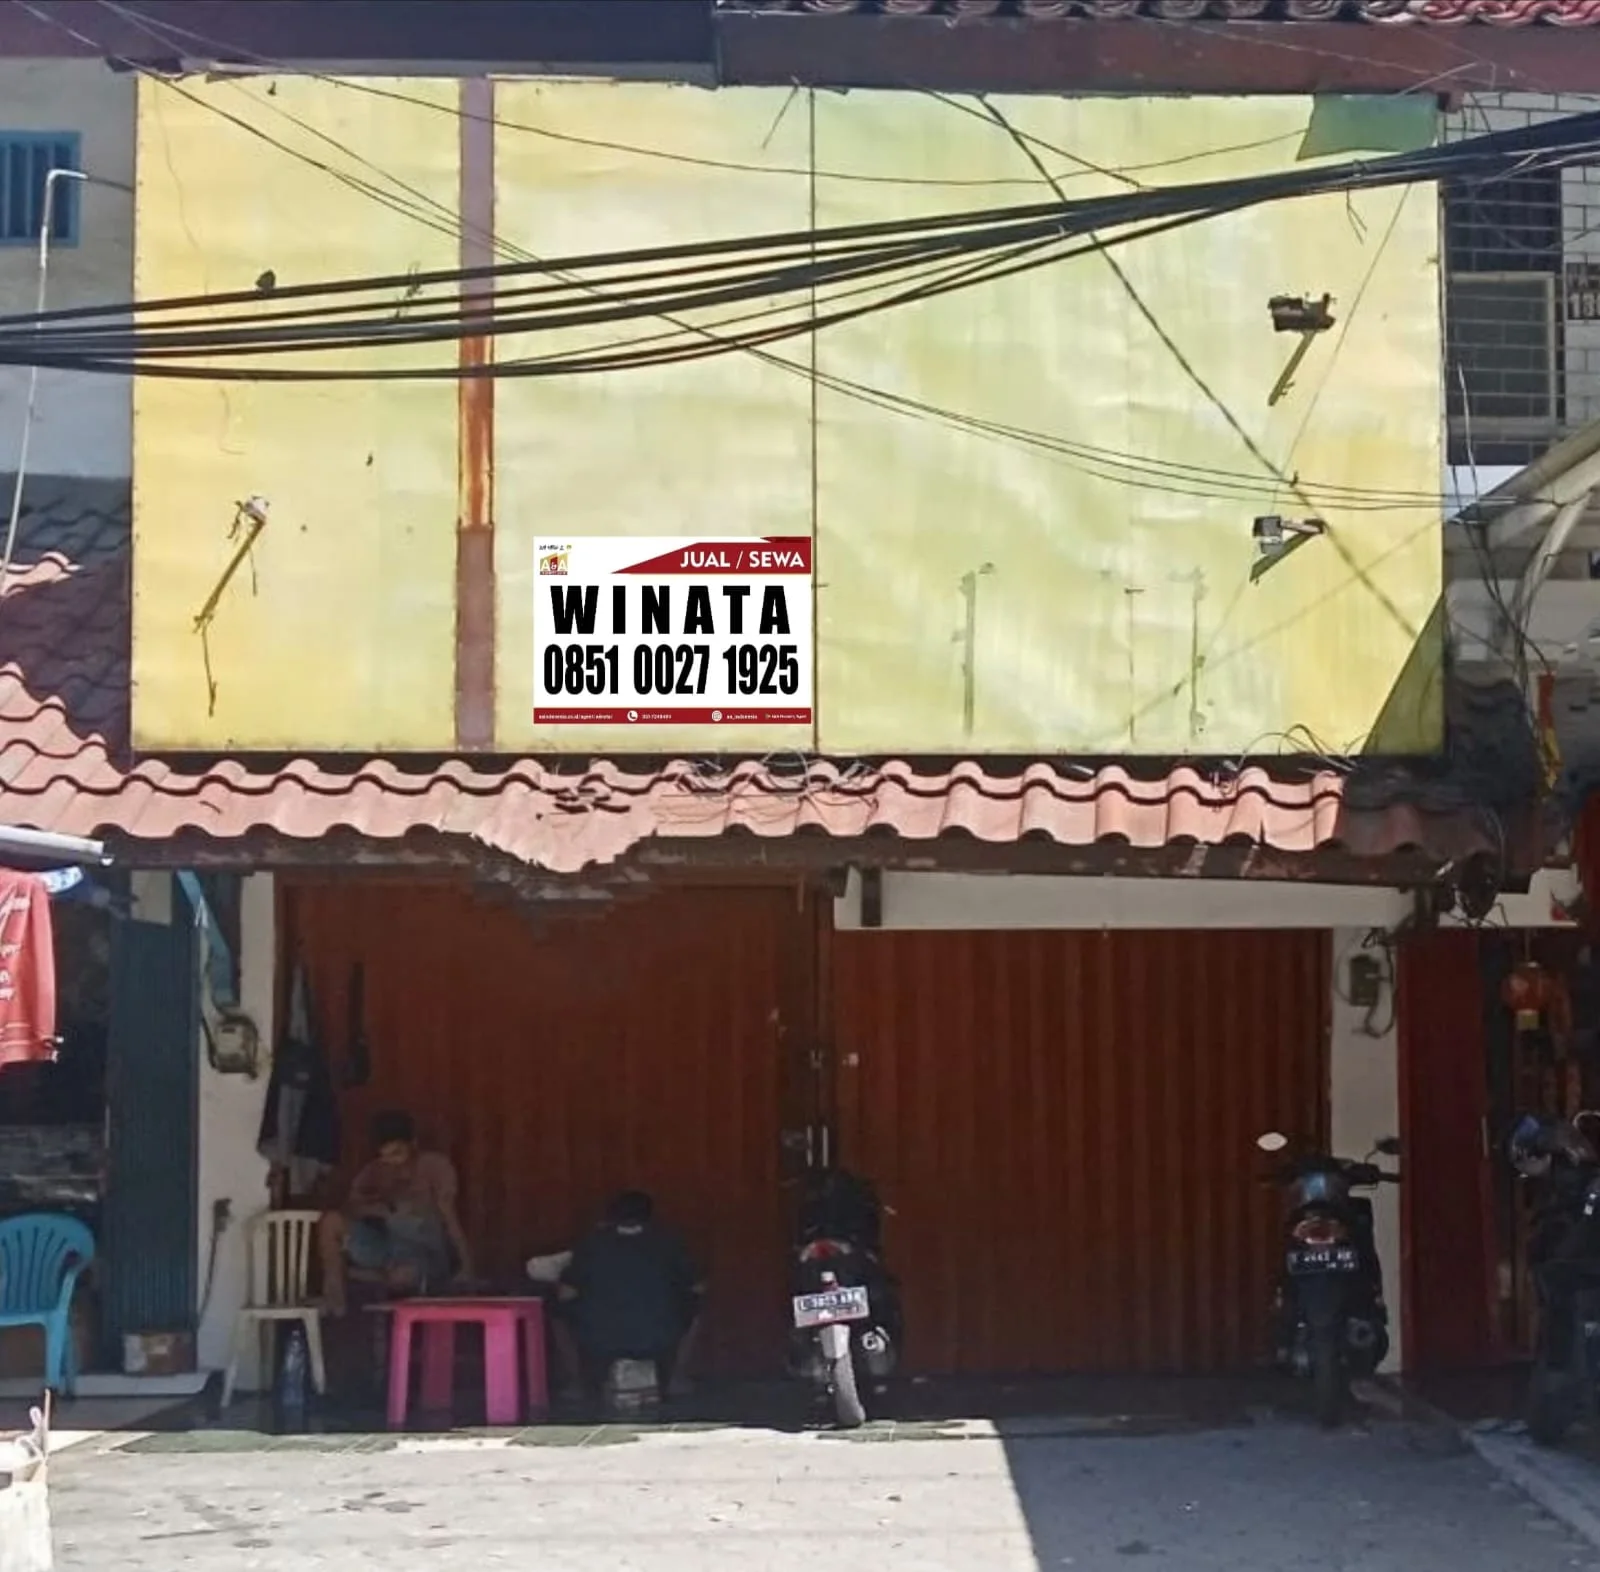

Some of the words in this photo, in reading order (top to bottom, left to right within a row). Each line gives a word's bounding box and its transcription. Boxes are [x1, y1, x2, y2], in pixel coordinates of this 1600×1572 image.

[680, 550, 731, 569] JUAL
[736, 550, 744, 570] /
[749, 550, 805, 569] SEWA
[550, 585, 791, 635] WINATA
[543, 643, 619, 696] 0851
[633, 643, 710, 696] 0027
[722, 643, 799, 696] 1925
